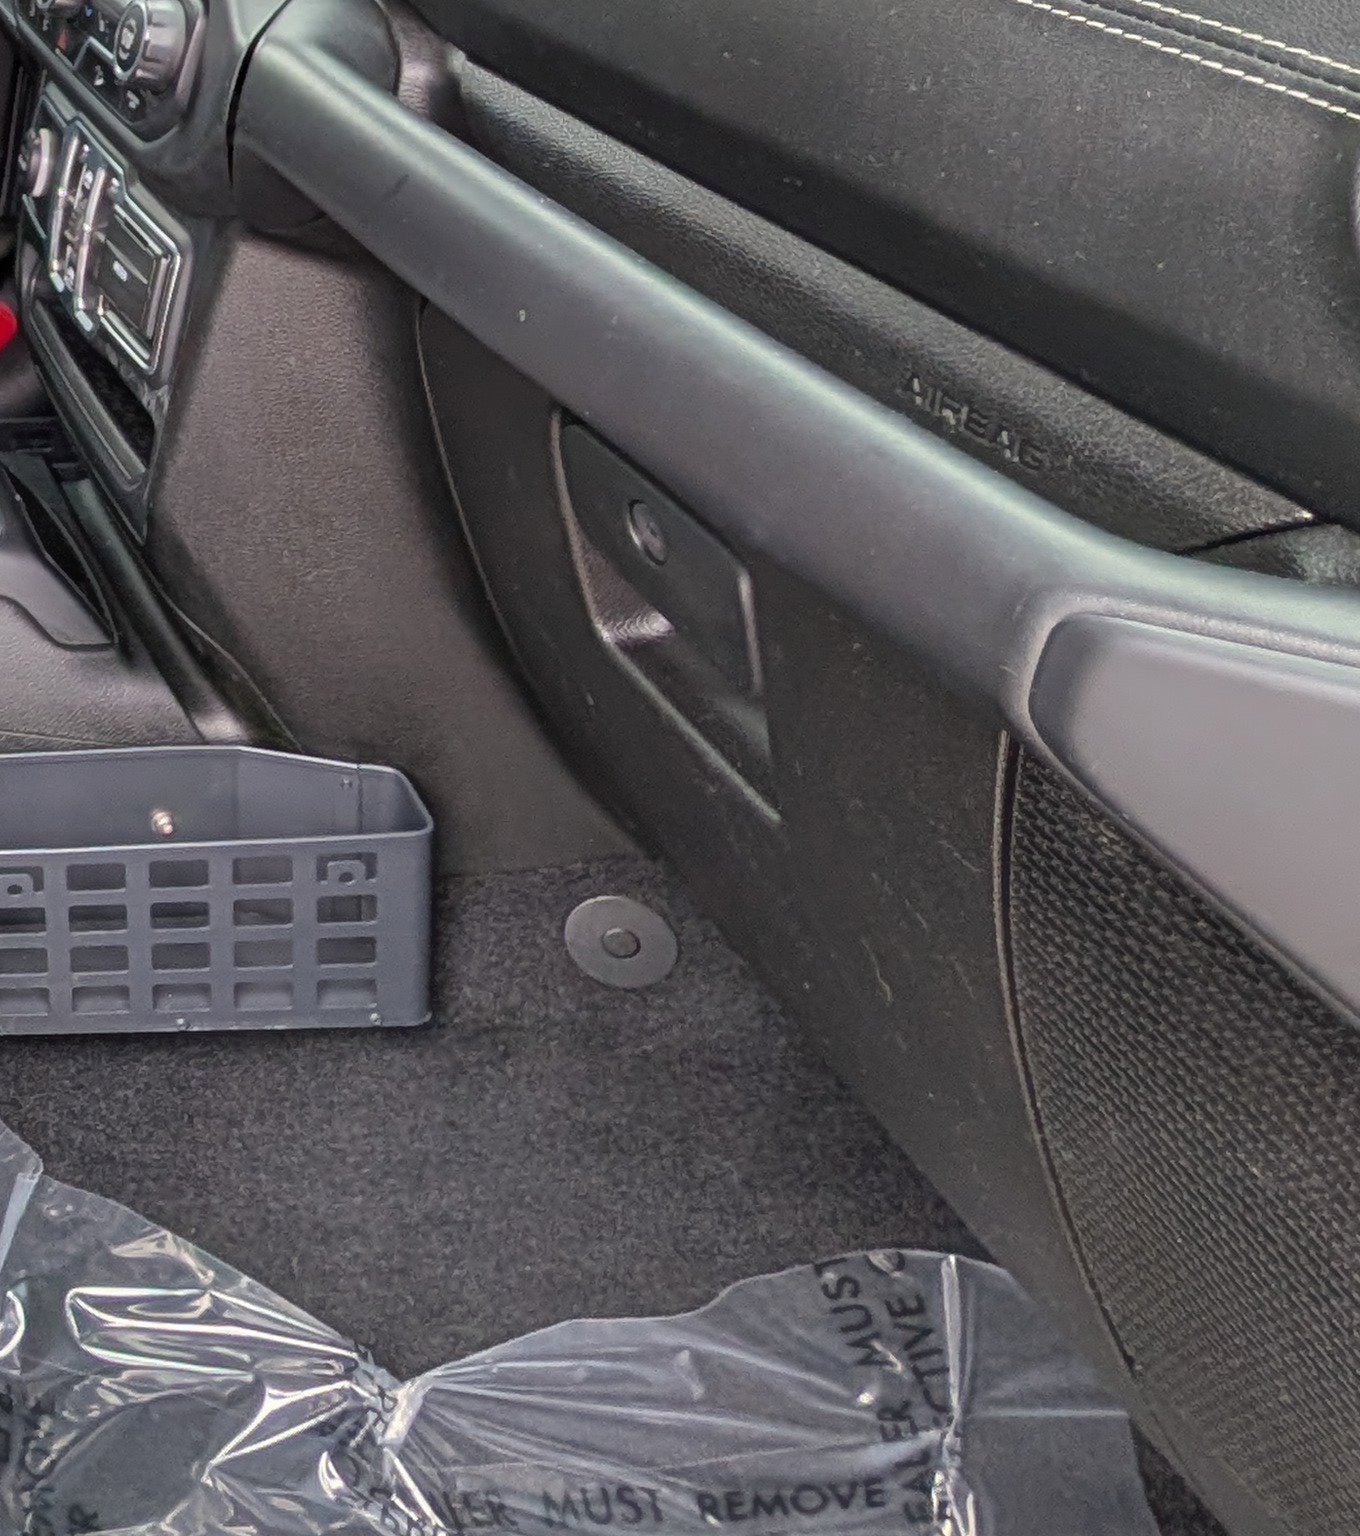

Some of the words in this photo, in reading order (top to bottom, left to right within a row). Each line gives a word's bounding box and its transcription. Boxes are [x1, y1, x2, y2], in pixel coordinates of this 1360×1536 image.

[894, 372, 1053, 477] AIRBAG
[542, 1483, 665, 1528] MUST
[696, 1477, 886, 1523] REMOVE
